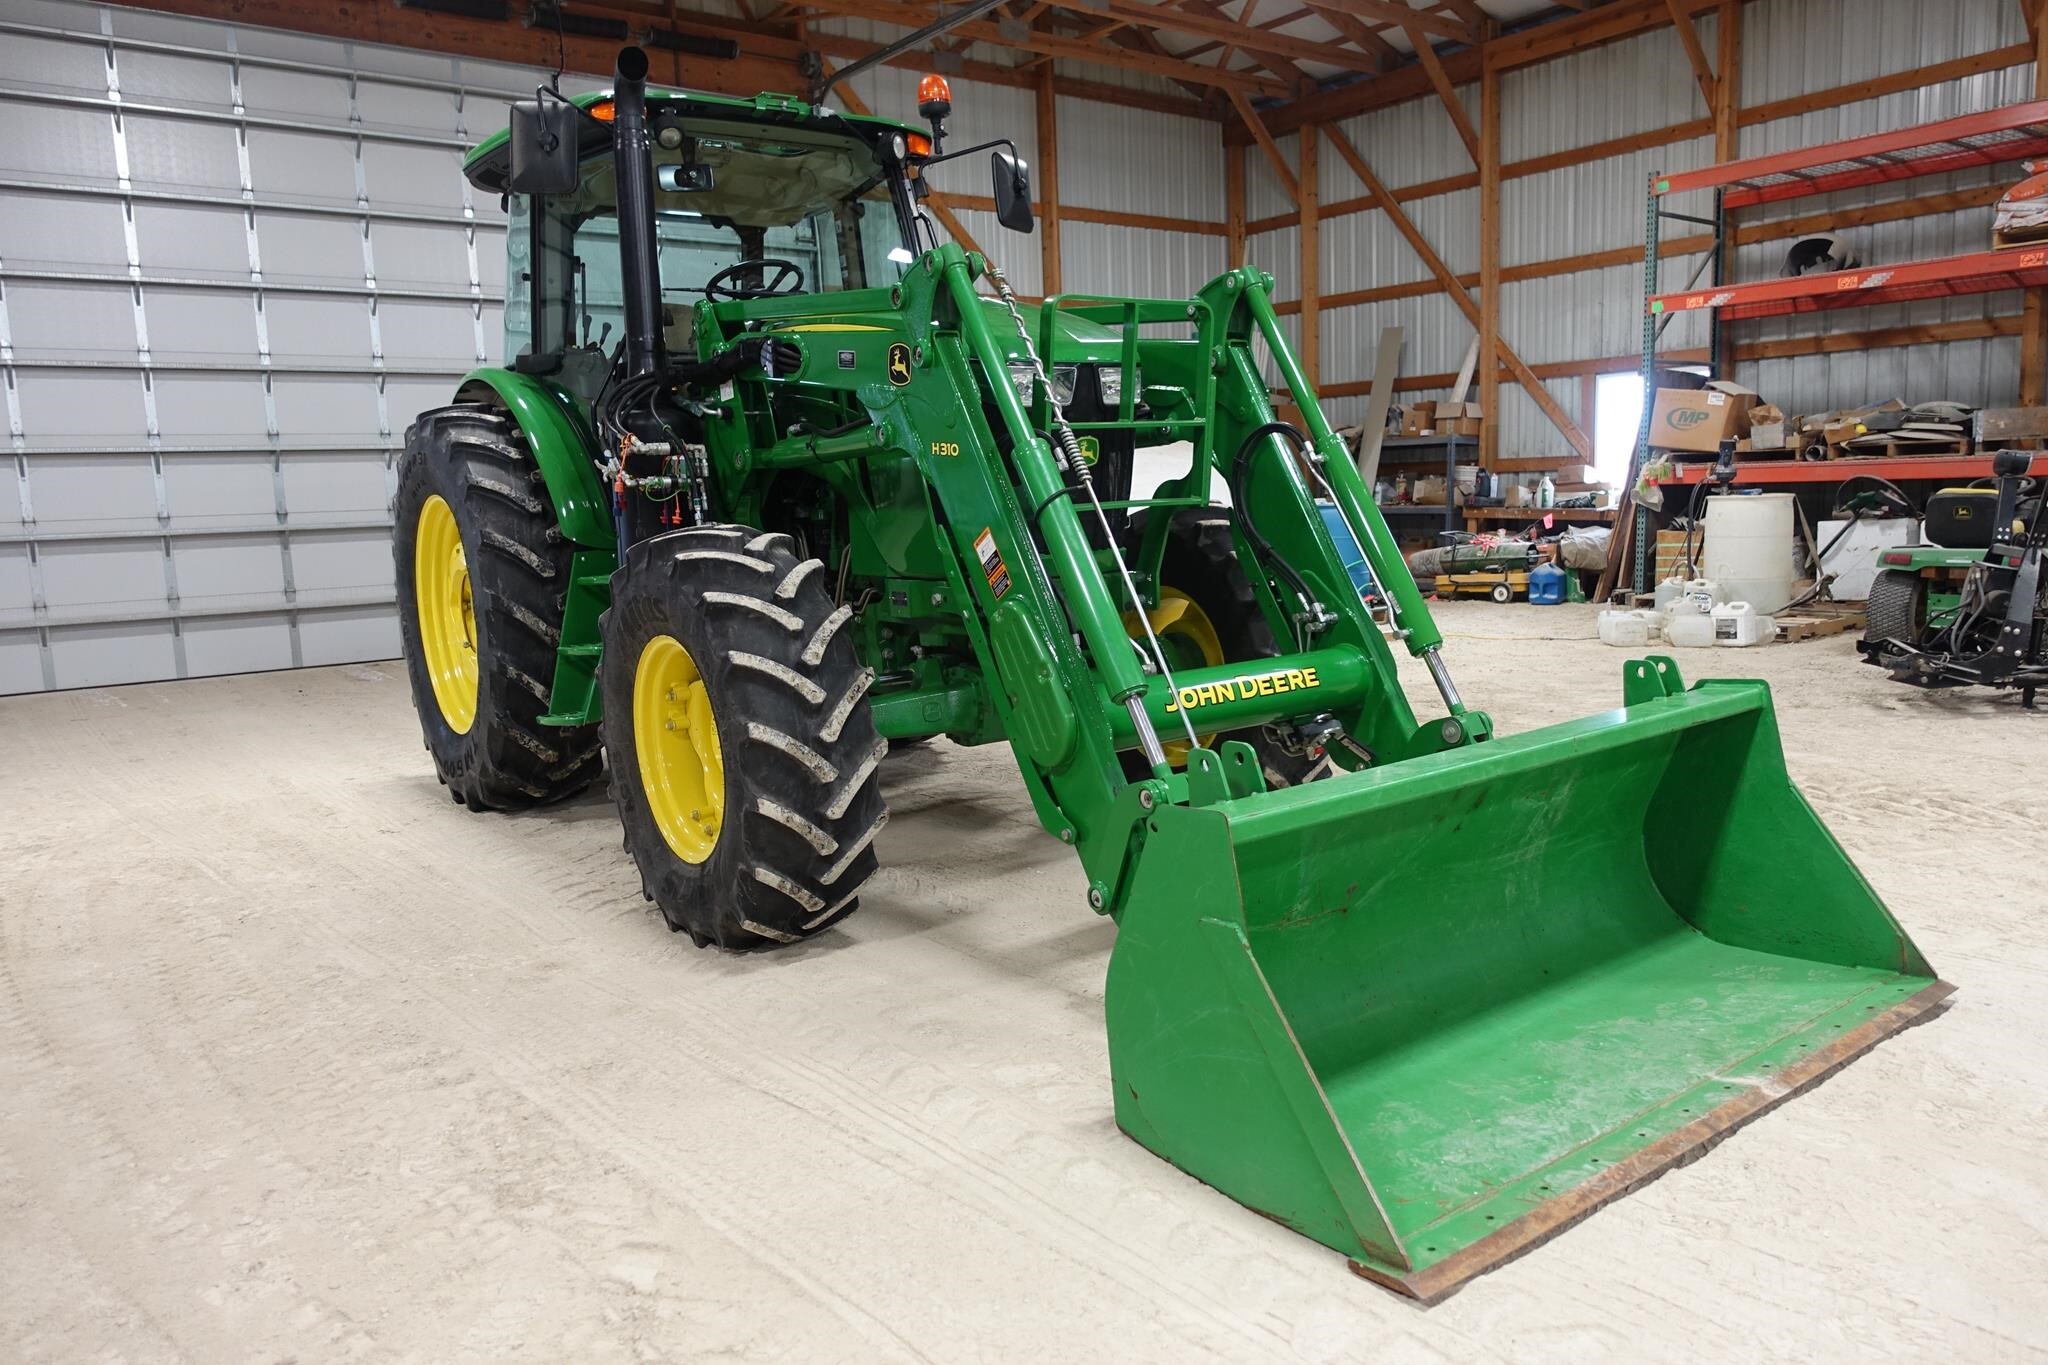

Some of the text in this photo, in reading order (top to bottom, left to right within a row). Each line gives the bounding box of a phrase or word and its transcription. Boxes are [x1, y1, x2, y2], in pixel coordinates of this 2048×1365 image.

[931, 442, 960, 457] H310
[1165, 667, 1320, 713] JOHN DEERE
